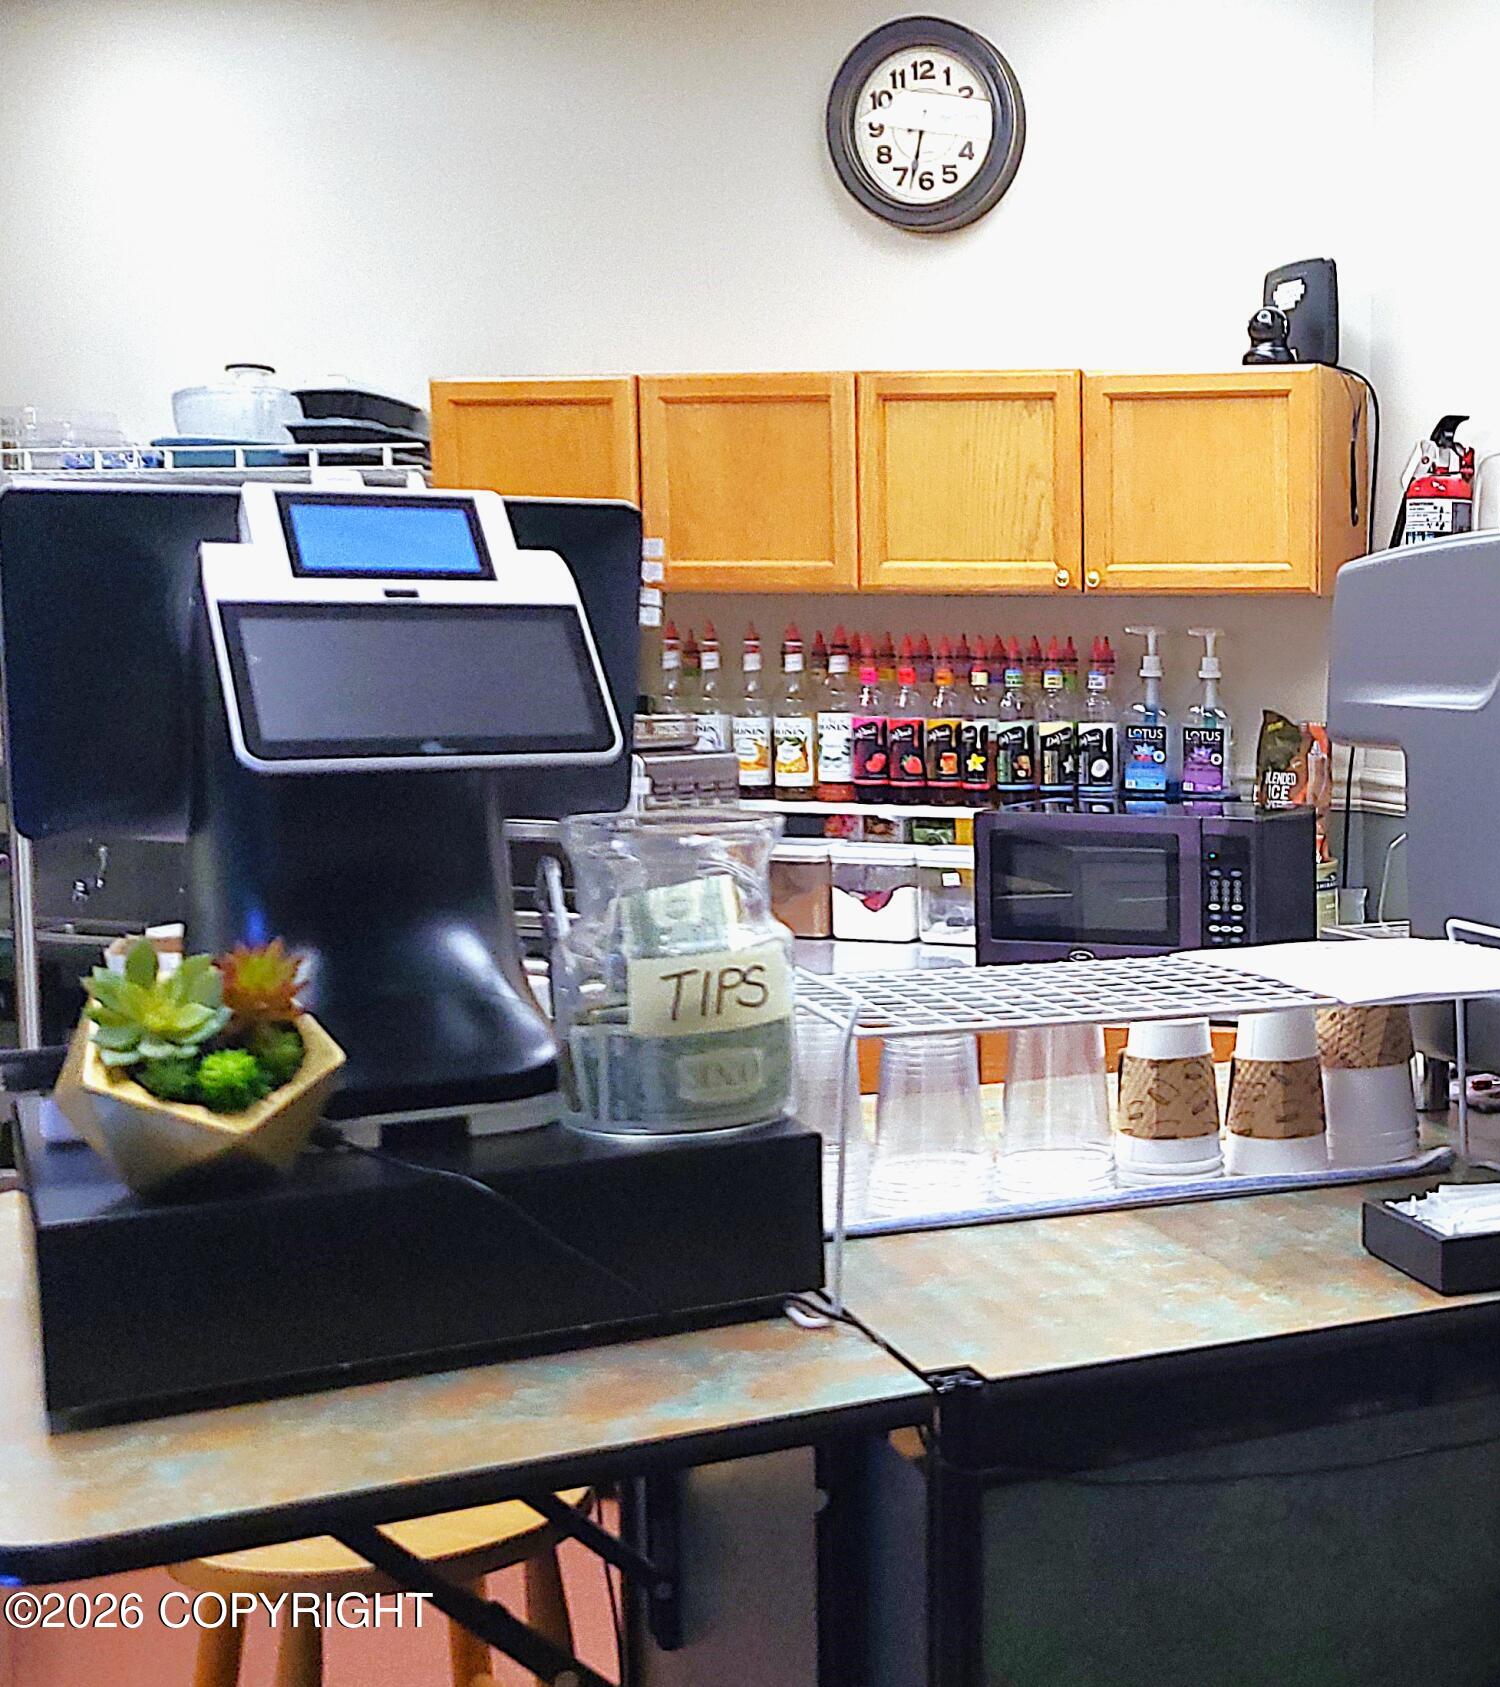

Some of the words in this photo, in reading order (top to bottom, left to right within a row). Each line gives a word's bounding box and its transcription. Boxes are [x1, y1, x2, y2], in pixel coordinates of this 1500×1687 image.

[890, 69, 906, 89] 11
[910, 60, 936, 81] 12
[942, 66, 951, 86] 1
[870, 90, 893, 110] 10
[876, 145, 892, 164] 8
[958, 141, 975, 160] 4
[893, 167, 909, 186] 7
[918, 171, 934, 190] 6
[942, 165, 958, 183] 5
[1127, 727, 1164, 739] LOTUS
[1185, 730, 1221, 741] LOTUS
[1268, 785, 1290, 800] ICE
[659, 964, 770, 1022] TIPS
